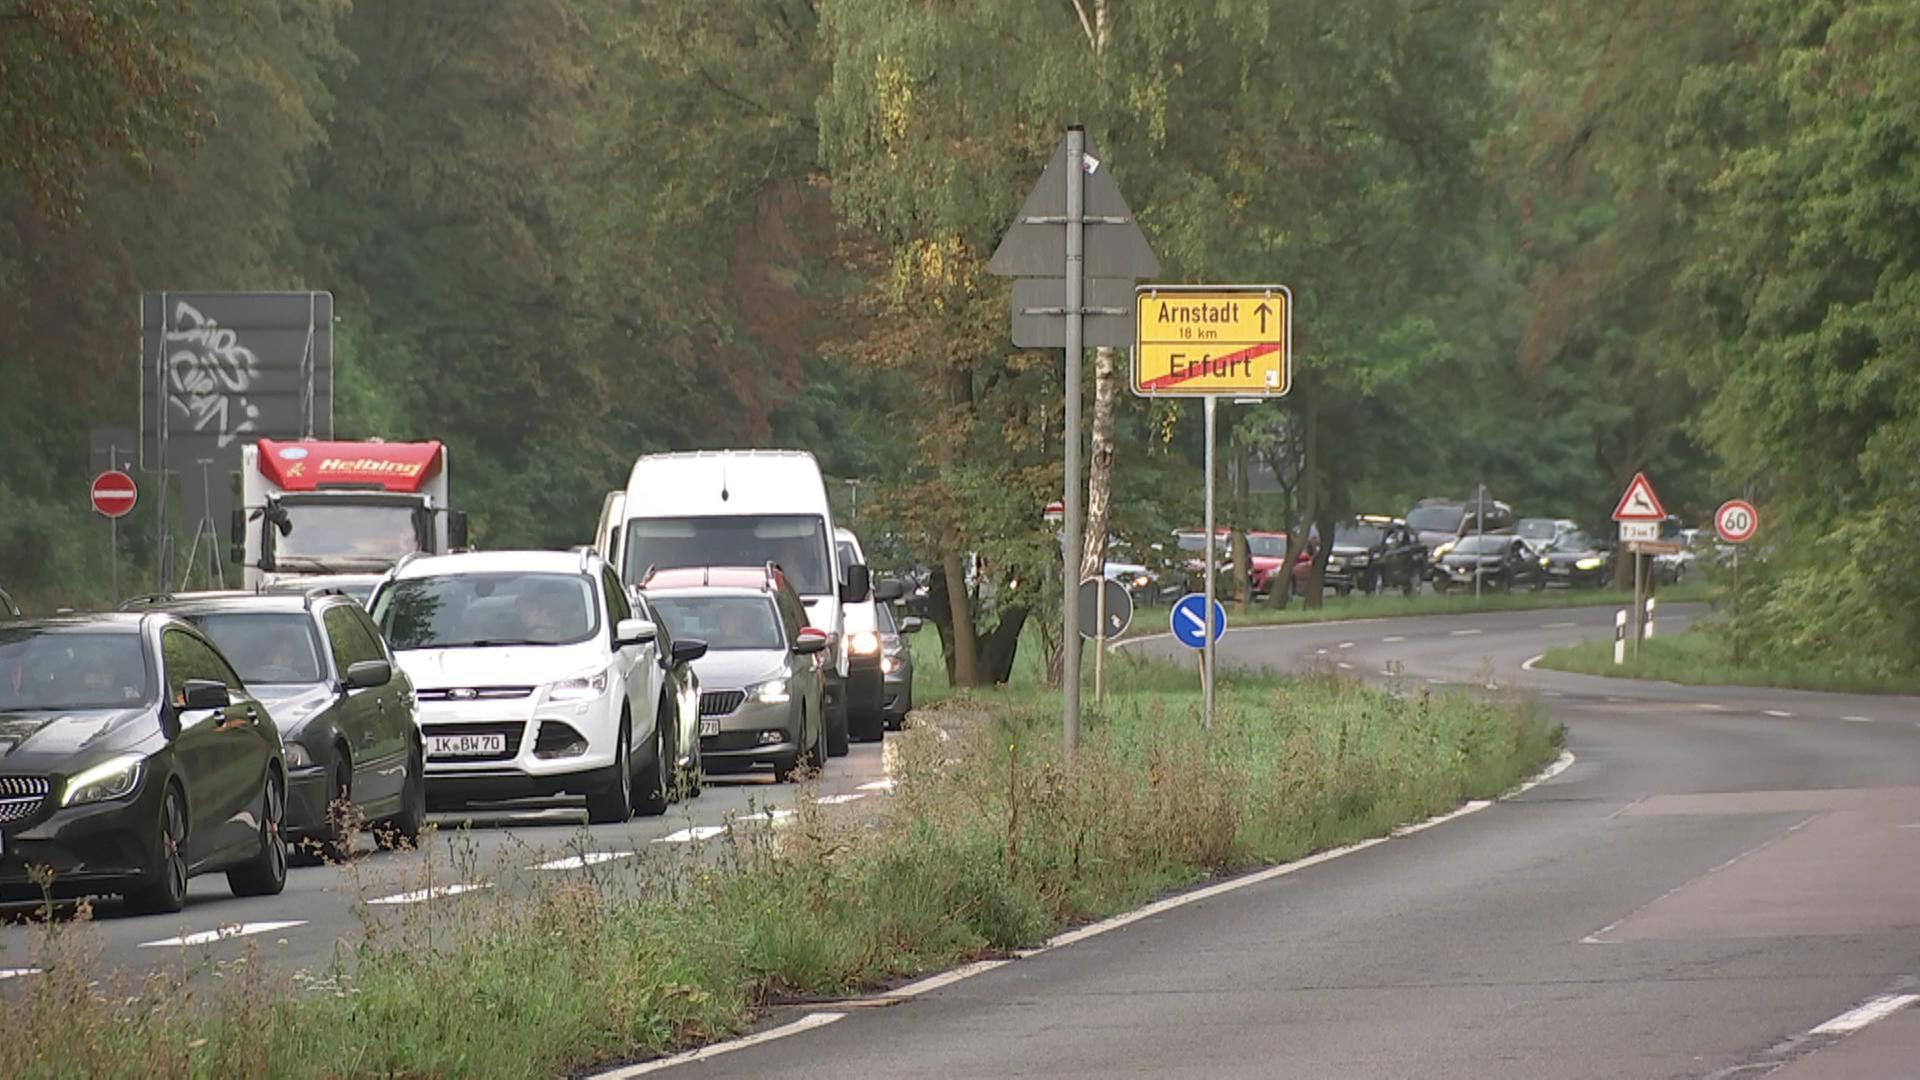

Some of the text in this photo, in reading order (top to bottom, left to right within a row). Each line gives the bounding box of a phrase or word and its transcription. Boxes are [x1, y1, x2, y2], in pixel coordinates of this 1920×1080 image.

[1158, 301, 1239, 323] Arnstadt
[1179, 327, 1217, 339] 18 km
[1170, 353, 1251, 378] Erfurt
[319, 458, 422, 477] Helbing
[1724, 512, 1748, 530] 60
[435, 736, 500, 752] IK BW 70
